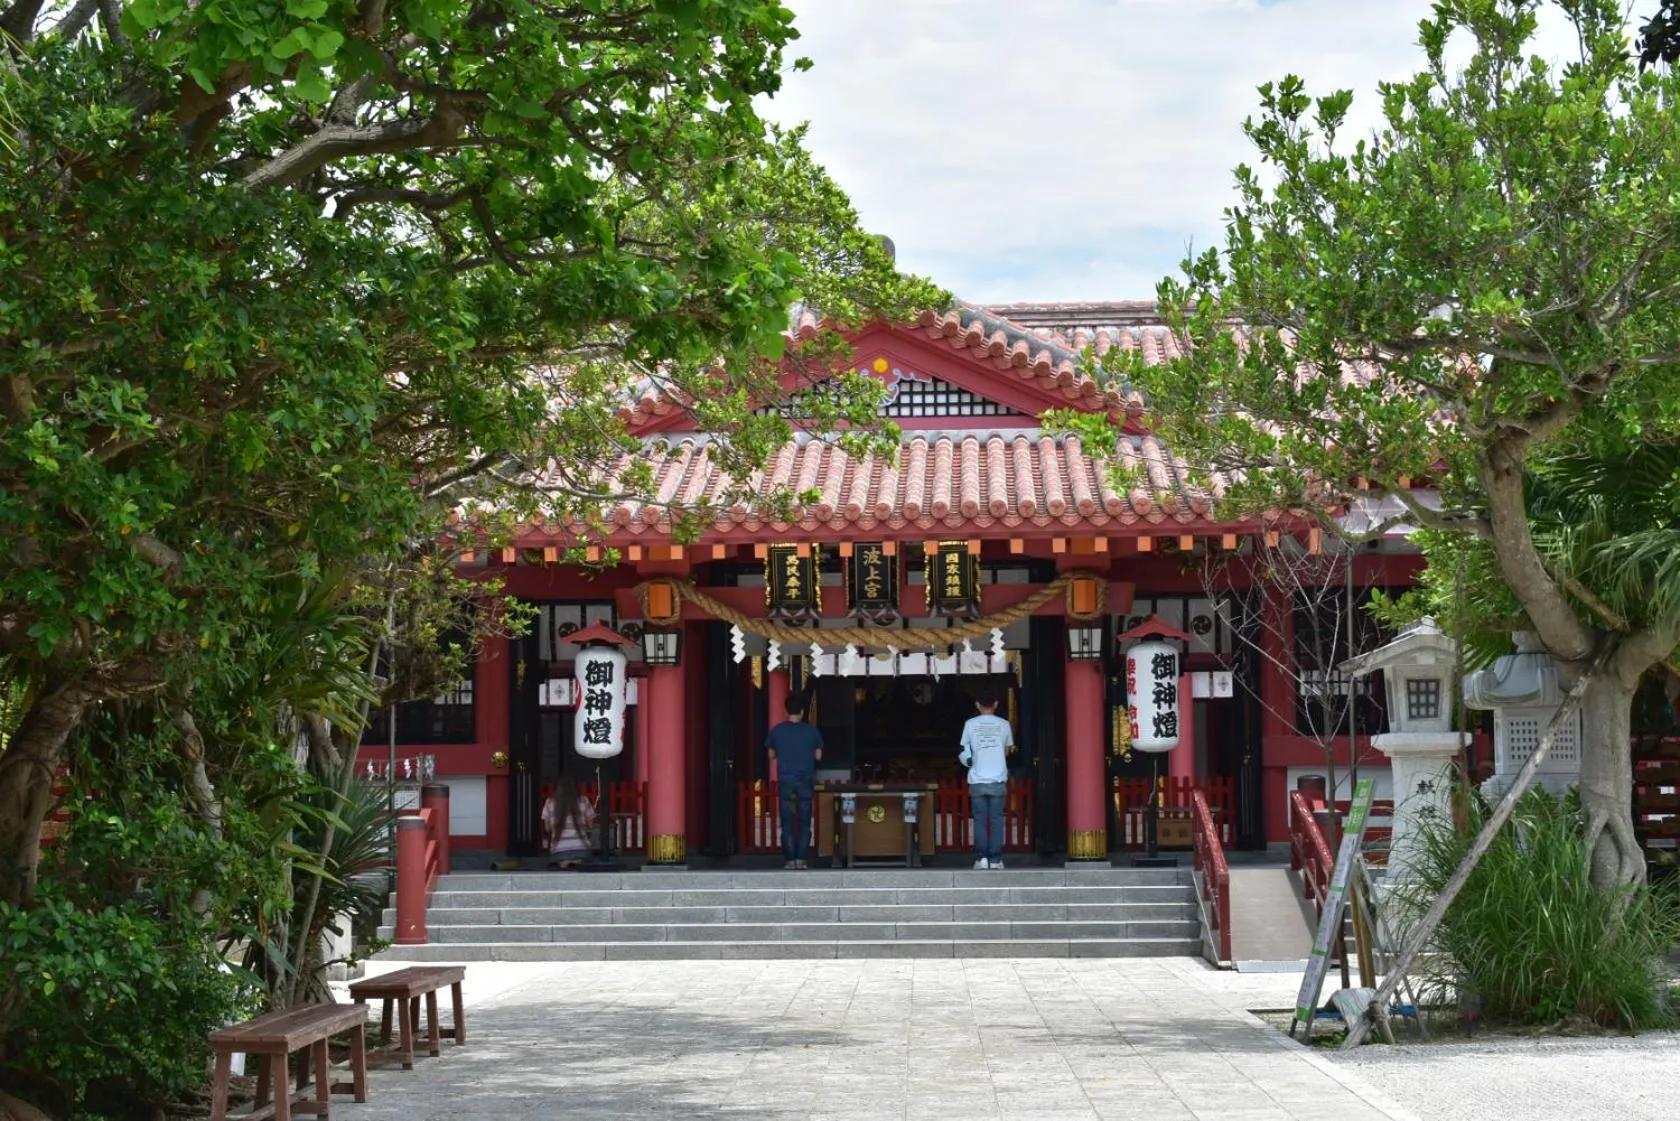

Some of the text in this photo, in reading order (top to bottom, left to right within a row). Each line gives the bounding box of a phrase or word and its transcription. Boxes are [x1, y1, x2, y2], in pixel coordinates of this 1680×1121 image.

[863, 546, 882, 599] 波上宮
[583, 659, 615, 745] 御神燈
[1151, 652, 1178, 739] 御神燈
